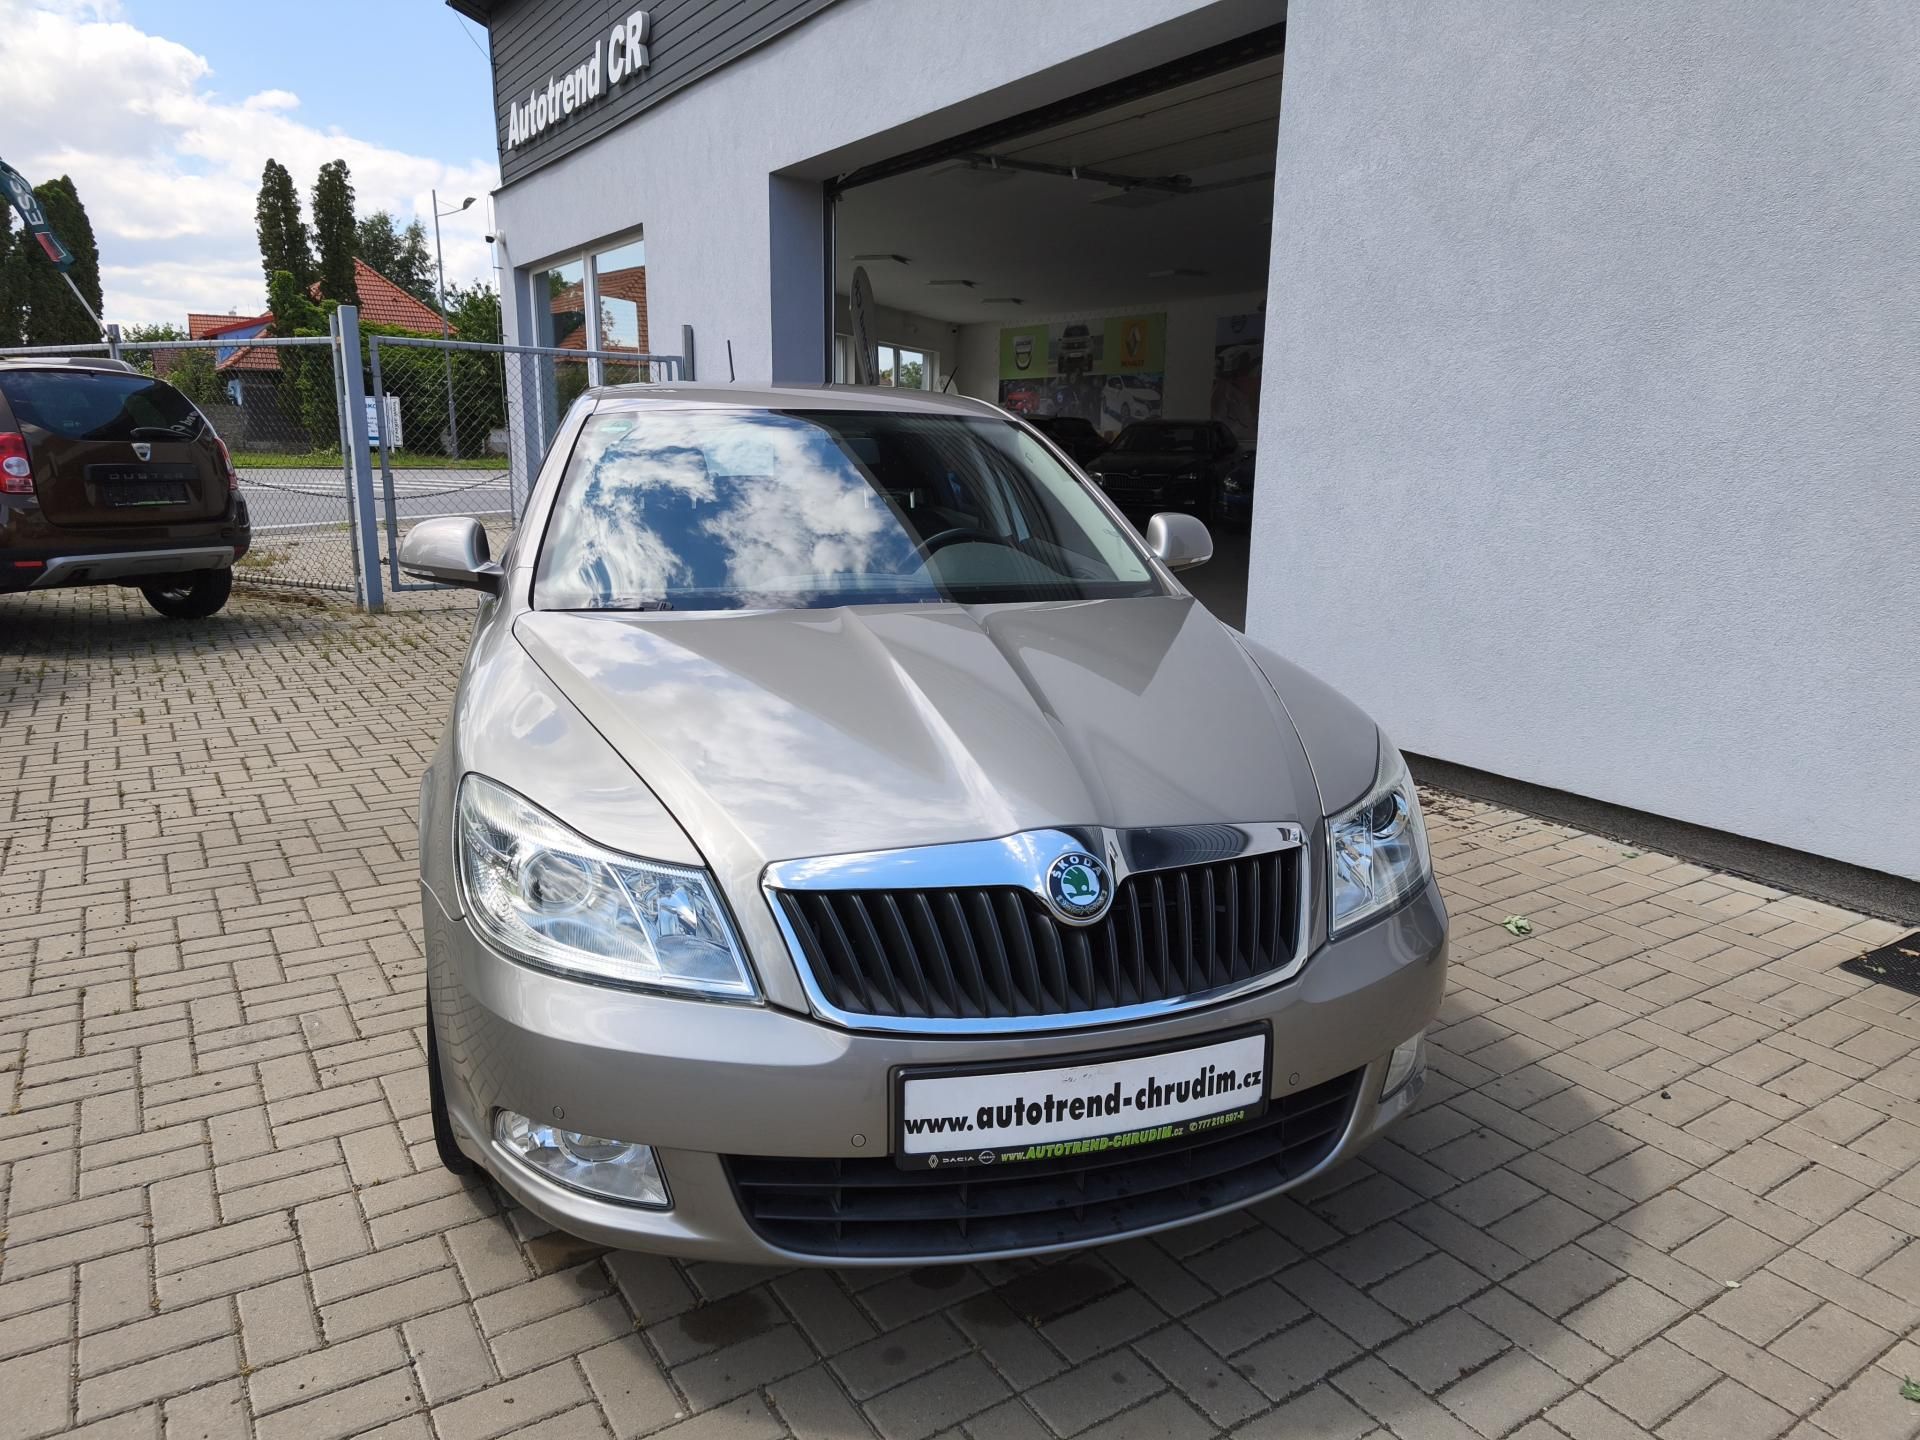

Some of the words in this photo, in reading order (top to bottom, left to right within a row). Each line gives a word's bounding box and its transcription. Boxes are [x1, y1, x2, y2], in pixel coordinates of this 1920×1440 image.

[508, 40, 603, 150] Autotrend
[608, 11, 648, 83] CR
[904, 1065, 1262, 1134] www.autotrend-chrudim.cz
[942, 1156, 975, 1164] DACIA
